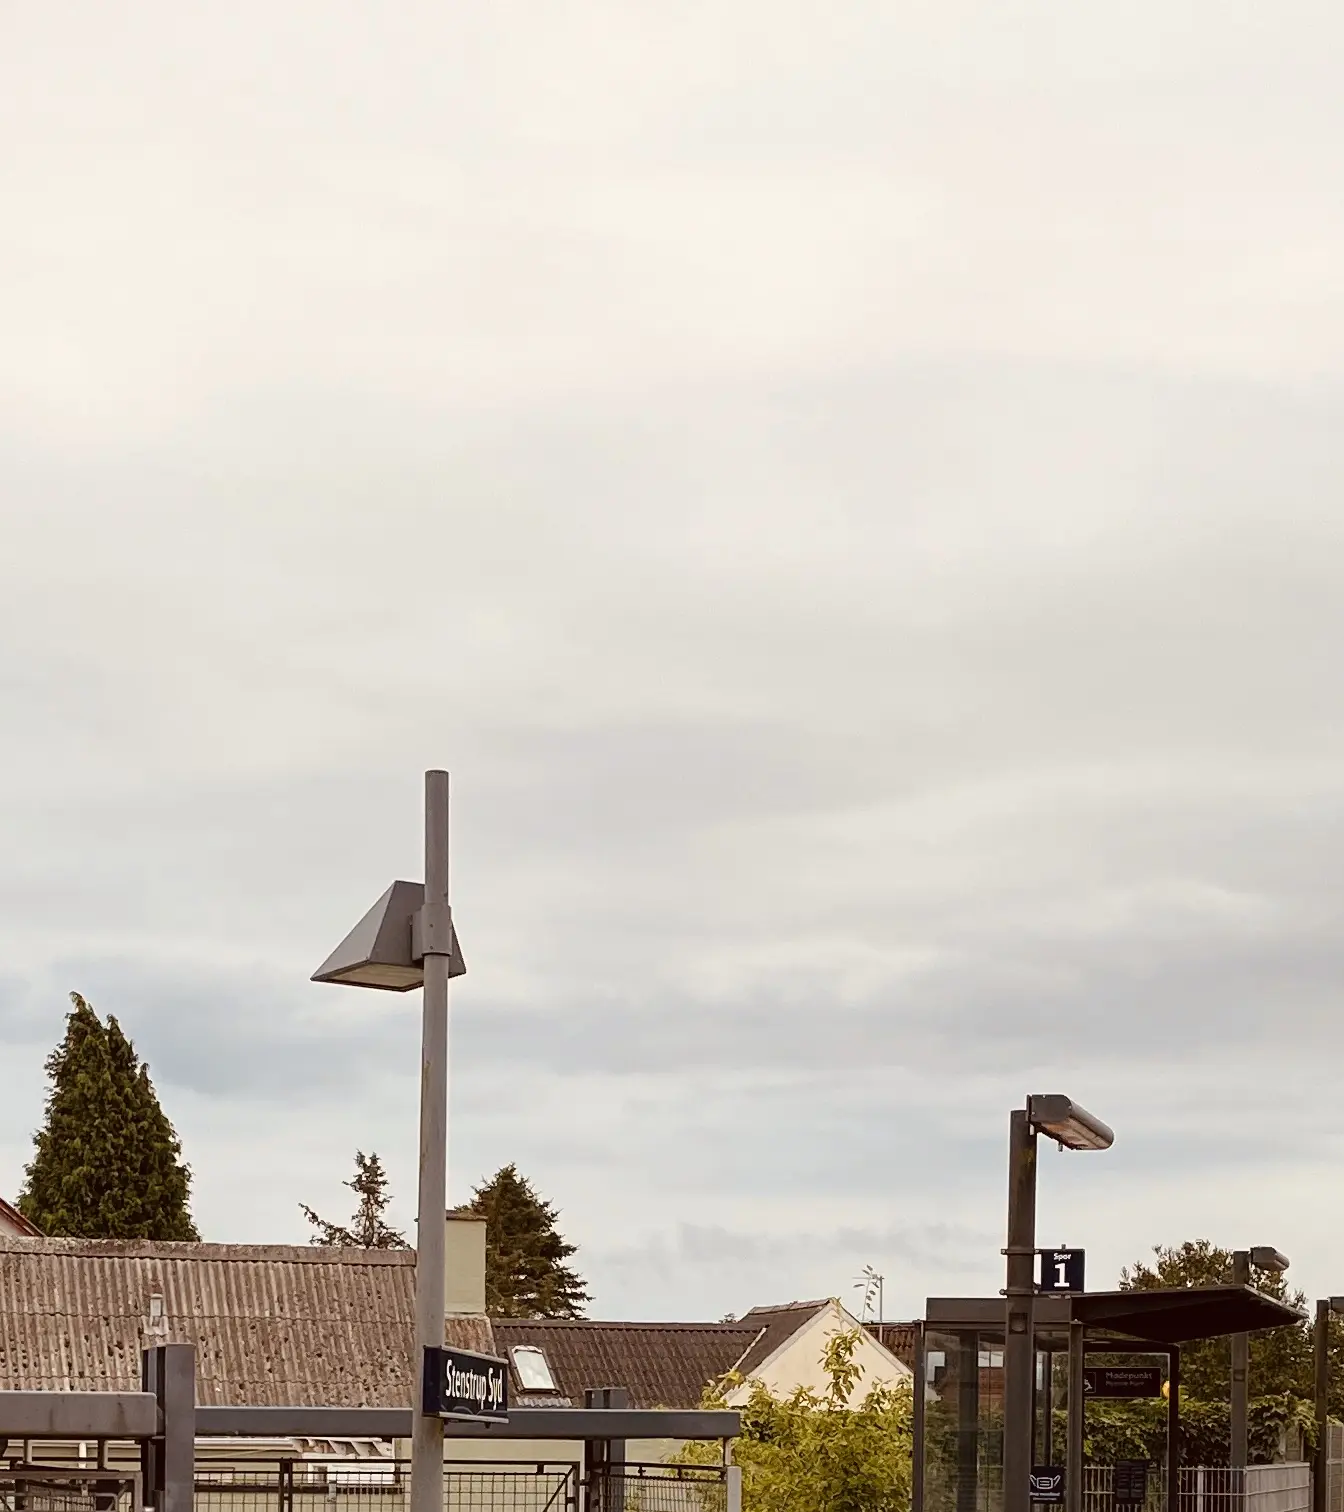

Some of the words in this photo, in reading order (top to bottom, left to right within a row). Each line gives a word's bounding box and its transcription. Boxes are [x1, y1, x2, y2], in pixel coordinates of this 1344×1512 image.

[1053, 1252, 1071, 1261] Spor
[1054, 1263, 1070, 1287] 1
[446, 1359, 486, 1410] Stenstrup
[488, 1367, 503, 1410] Syd
